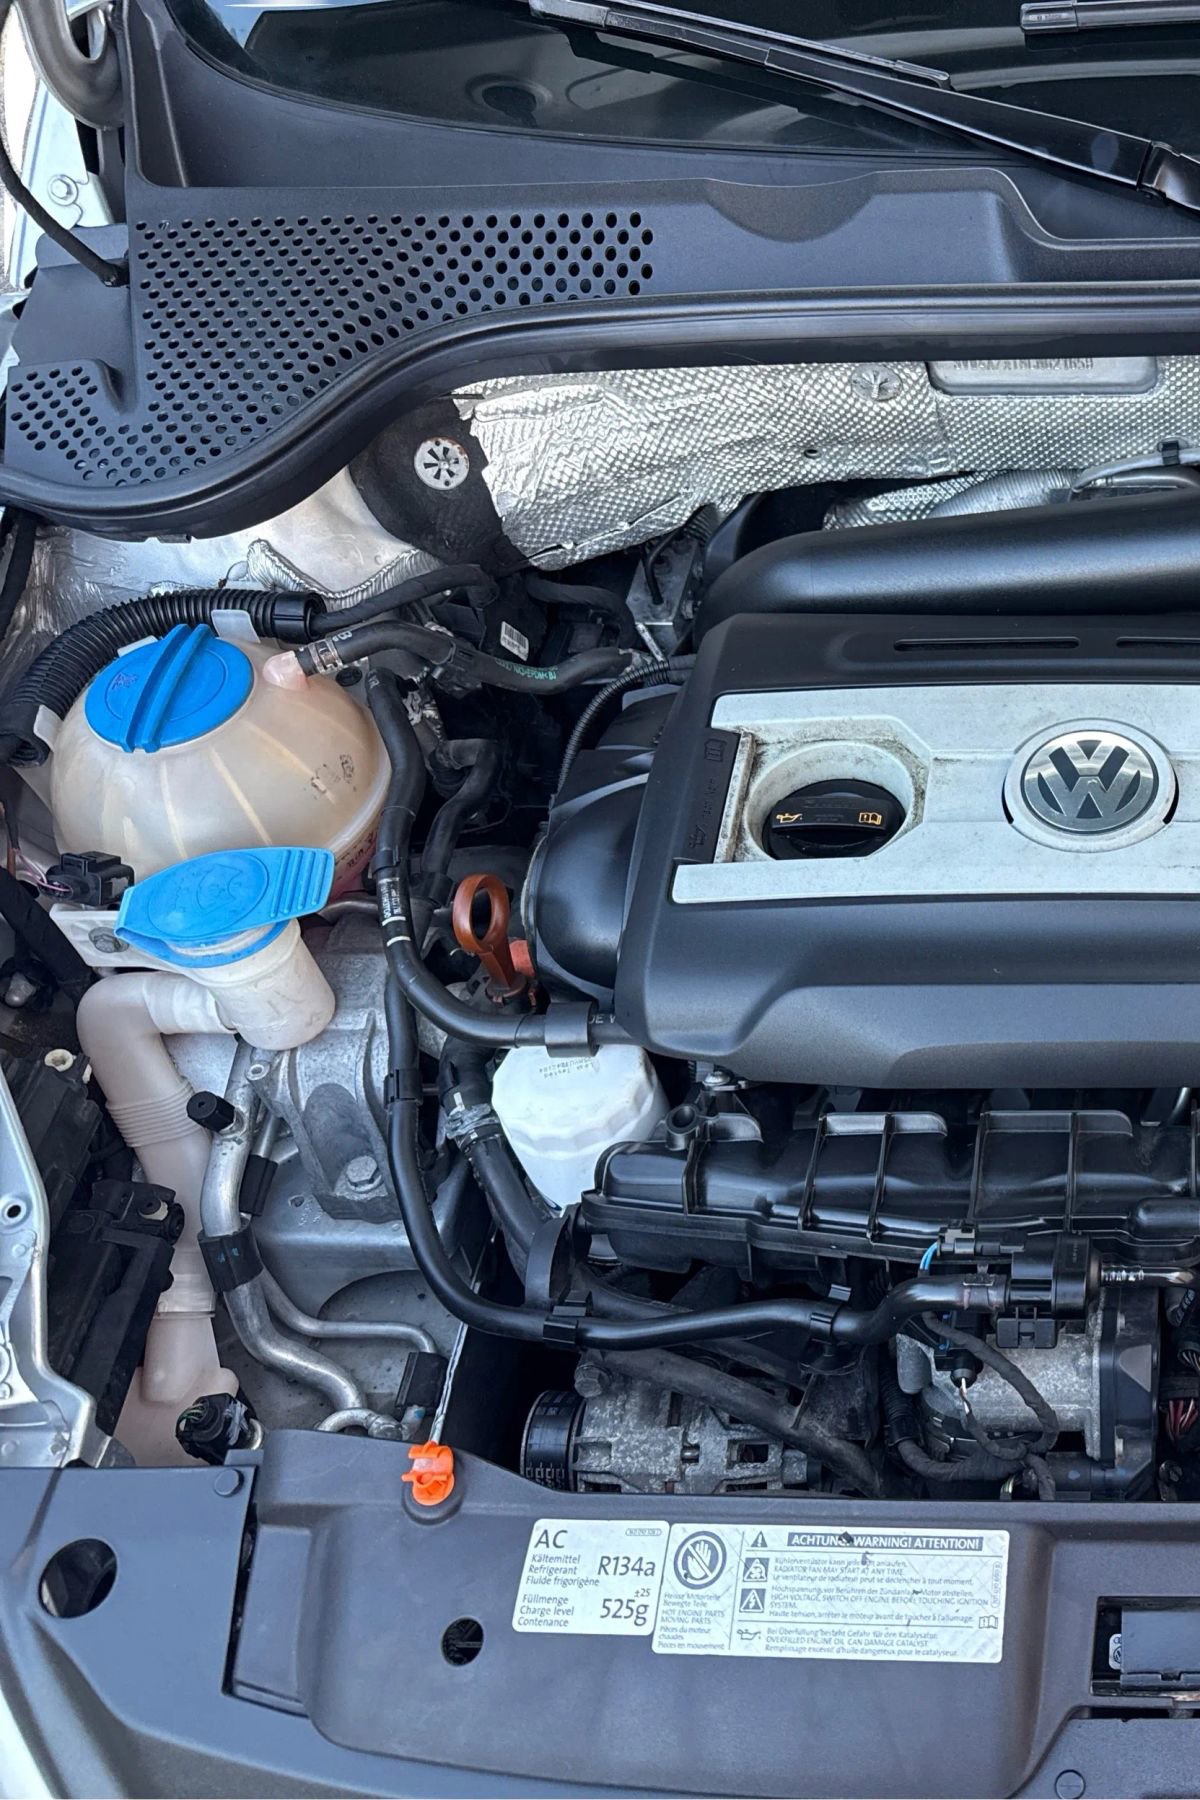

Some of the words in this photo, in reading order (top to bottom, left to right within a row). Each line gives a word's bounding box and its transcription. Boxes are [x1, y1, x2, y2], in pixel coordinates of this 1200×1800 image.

[1023, 731, 1157, 833] VW
[534, 1529, 568, 1549] AC
[853, 1535, 912, 1549] WARNING!
[913, 1537, 980, 1550] ATTENTION!
[531, 1554, 581, 1564] Kältemittel
[528, 1564, 578, 1576] Refrigerant
[597, 1555, 656, 1577] R134a
[774, 1565, 808, 1573] RADIATOR
[840, 1566, 860, 1574] START
[525, 1575, 552, 1585] Fluide
[553, 1576, 600, 1589] frigorigène
[634, 1588, 651, 1598] ±25
[522, 1594, 569, 1606] Füllmenge
[918, 1597, 955, 1605] TOUCHING
[957, 1598, 989, 1606] IGNITION
[519, 1605, 552, 1617] Charge
[553, 1606, 575, 1616] level
[599, 1598, 650, 1627] 525g
[704, 1609, 725, 1617] PARTS
[517, 1617, 569, 1627] Contenance
[691, 1616, 712, 1624] PARTS
[679, 1625, 687, 1633] du
[766, 1636, 806, 1644] OVERFILLED
[806, 1637, 833, 1645] ENGINE
[847, 1638, 863, 1646] CAN
[864, 1639, 894, 1647] DAMAGE
